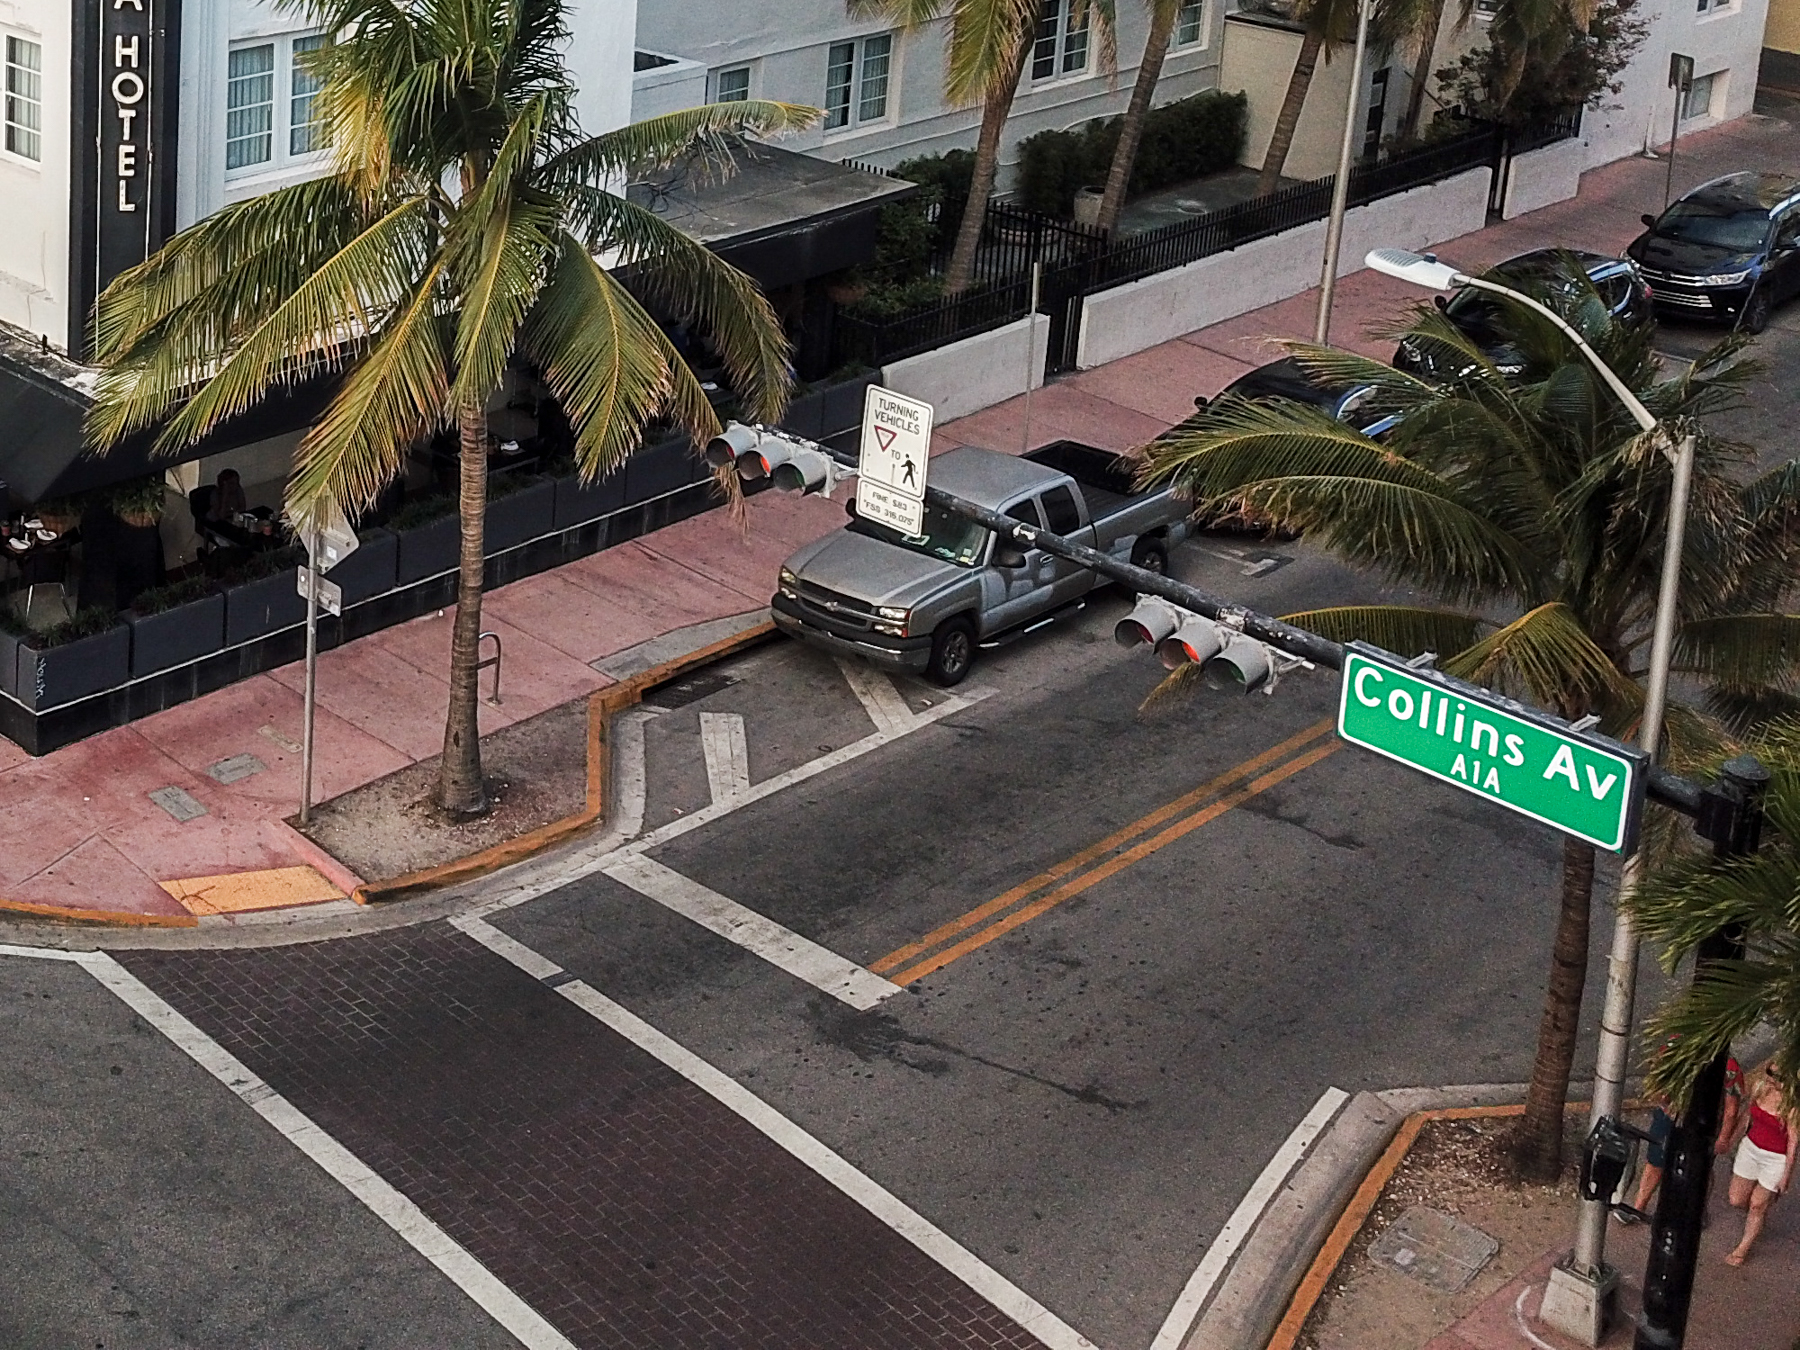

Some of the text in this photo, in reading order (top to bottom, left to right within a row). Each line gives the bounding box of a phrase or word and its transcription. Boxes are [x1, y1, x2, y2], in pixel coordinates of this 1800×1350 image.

[111, 33, 139, 213] HOTEL
[874, 409, 920, 436] VEHICLES
[878, 397, 919, 422] TURNING
[890, 449, 901, 461] TO
[872, 491, 888, 504] FINE
[1354, 666, 1618, 801] Collins Av
[1450, 753, 1501, 794] A1A
